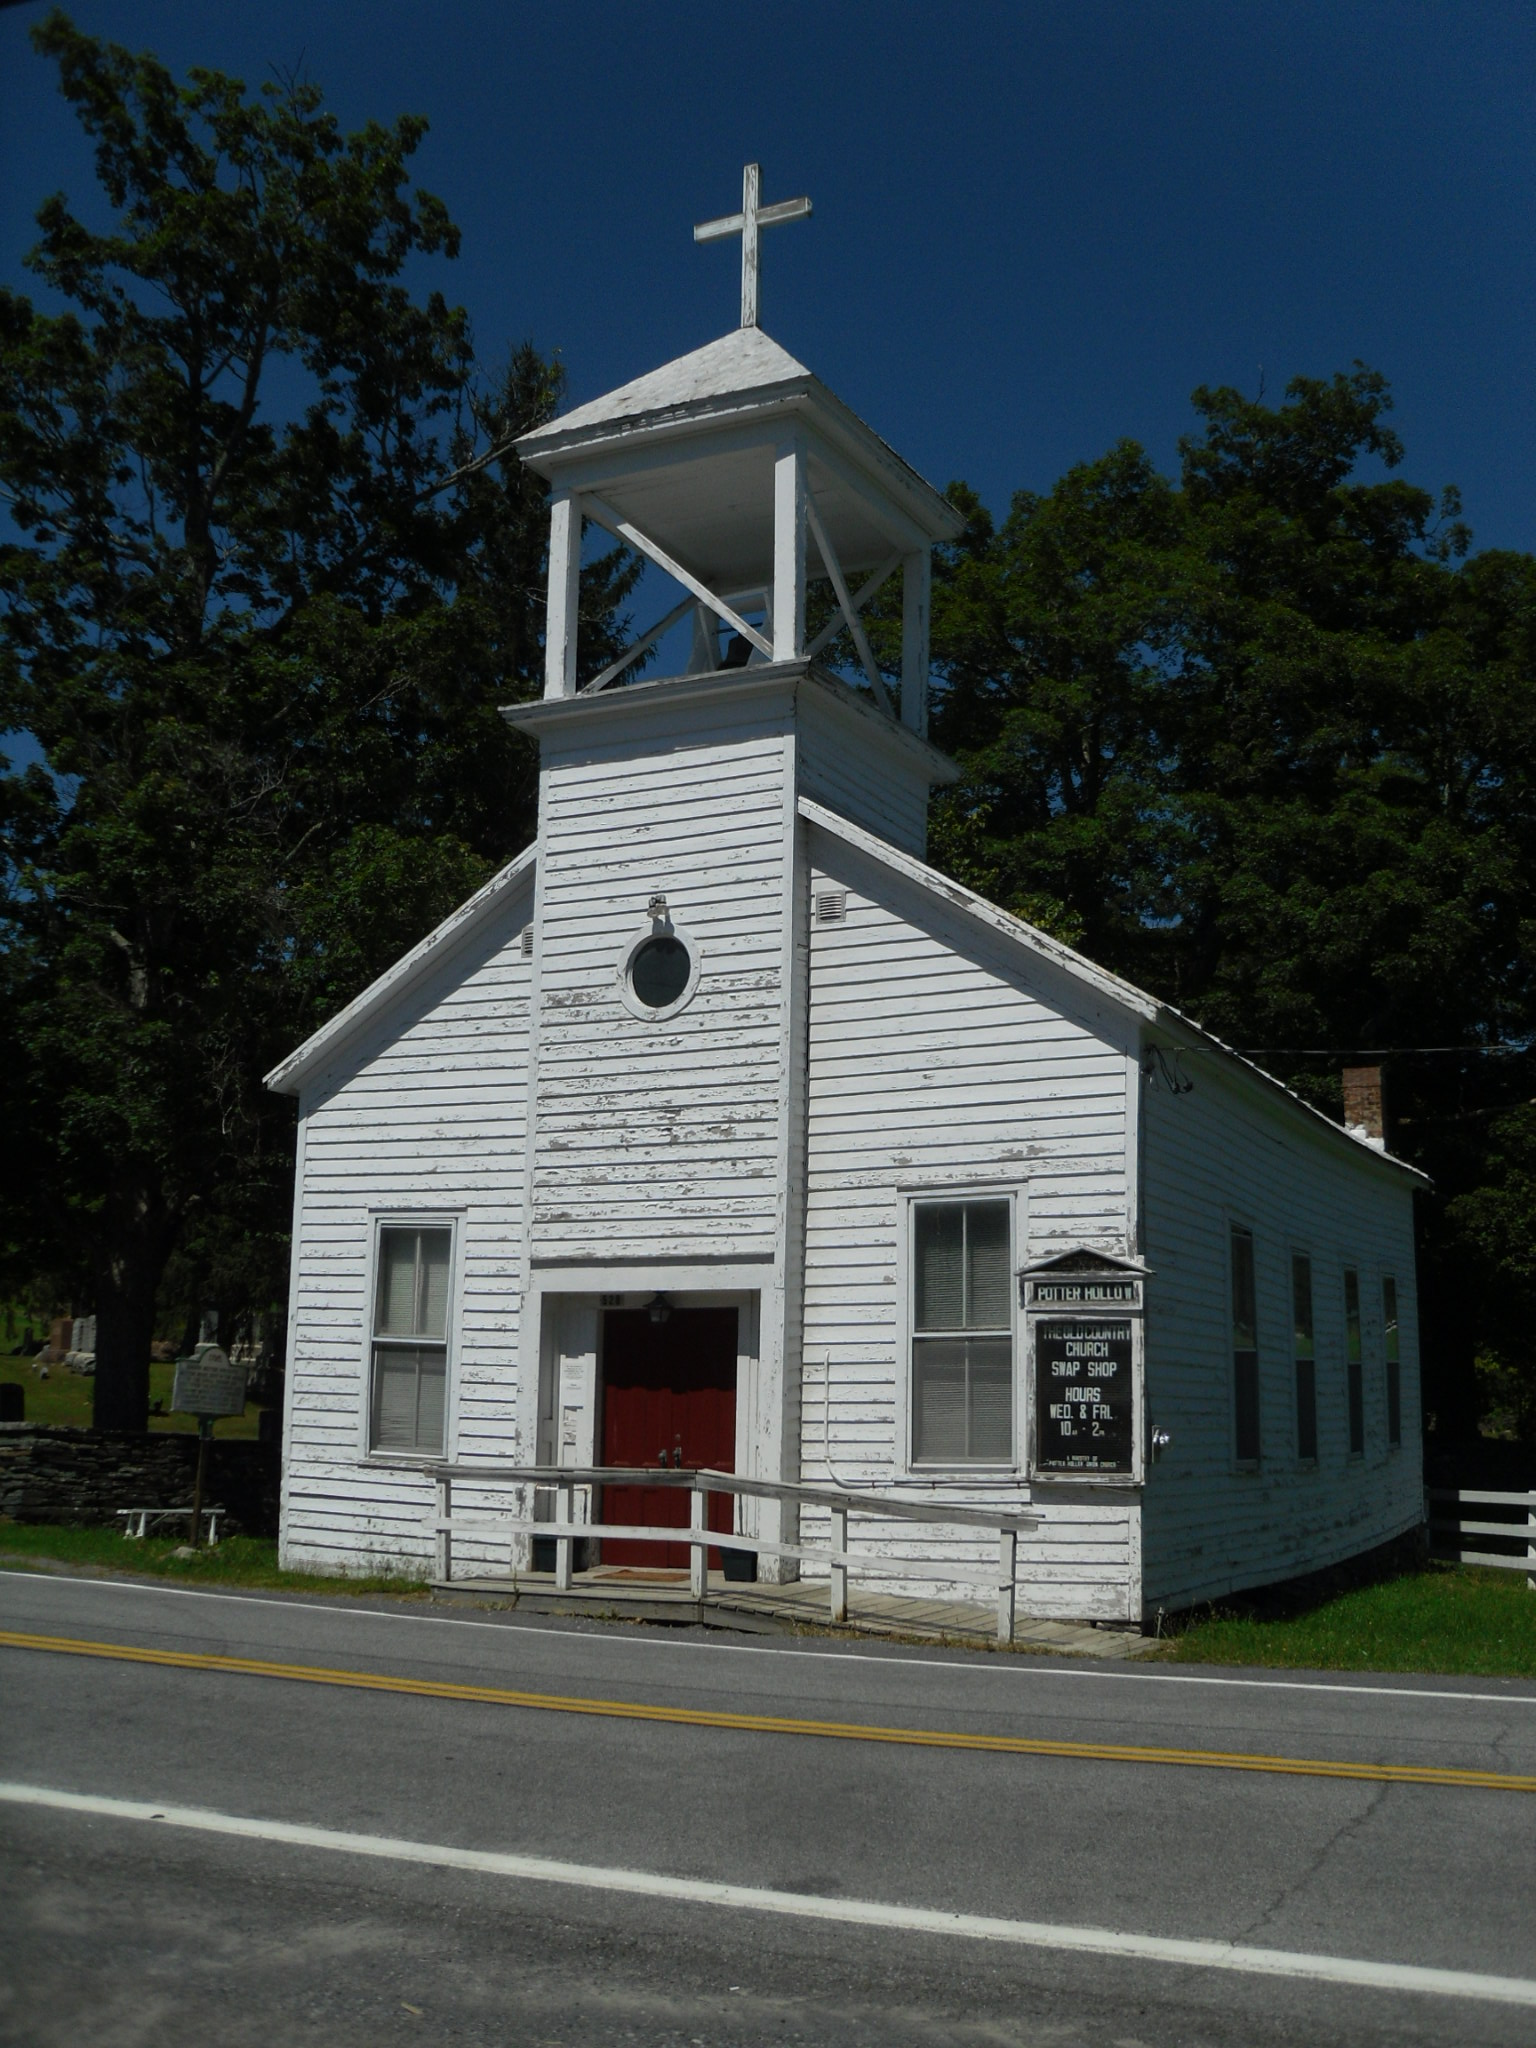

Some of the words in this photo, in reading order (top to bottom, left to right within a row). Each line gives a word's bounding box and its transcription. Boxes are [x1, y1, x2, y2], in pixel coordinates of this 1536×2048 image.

[1038, 1286, 1080, 1301] POTTER
[1084, 1286, 1131, 1301] HOLLOW
[1043, 1325, 1062, 1340] THE
[1063, 1325, 1084, 1340] OLD
[1084, 1325, 1131, 1341] COUNTRY
[1065, 1341, 1109, 1357] CHURCH
[1051, 1361, 1081, 1377] SWAP
[1087, 1361, 1117, 1377] SHOP
[1065, 1386, 1102, 1402] HOURS
[1049, 1403, 1074, 1419] WED.
[1079, 1403, 1087, 1419] &
[1092, 1404, 1114, 1420] FRI.
